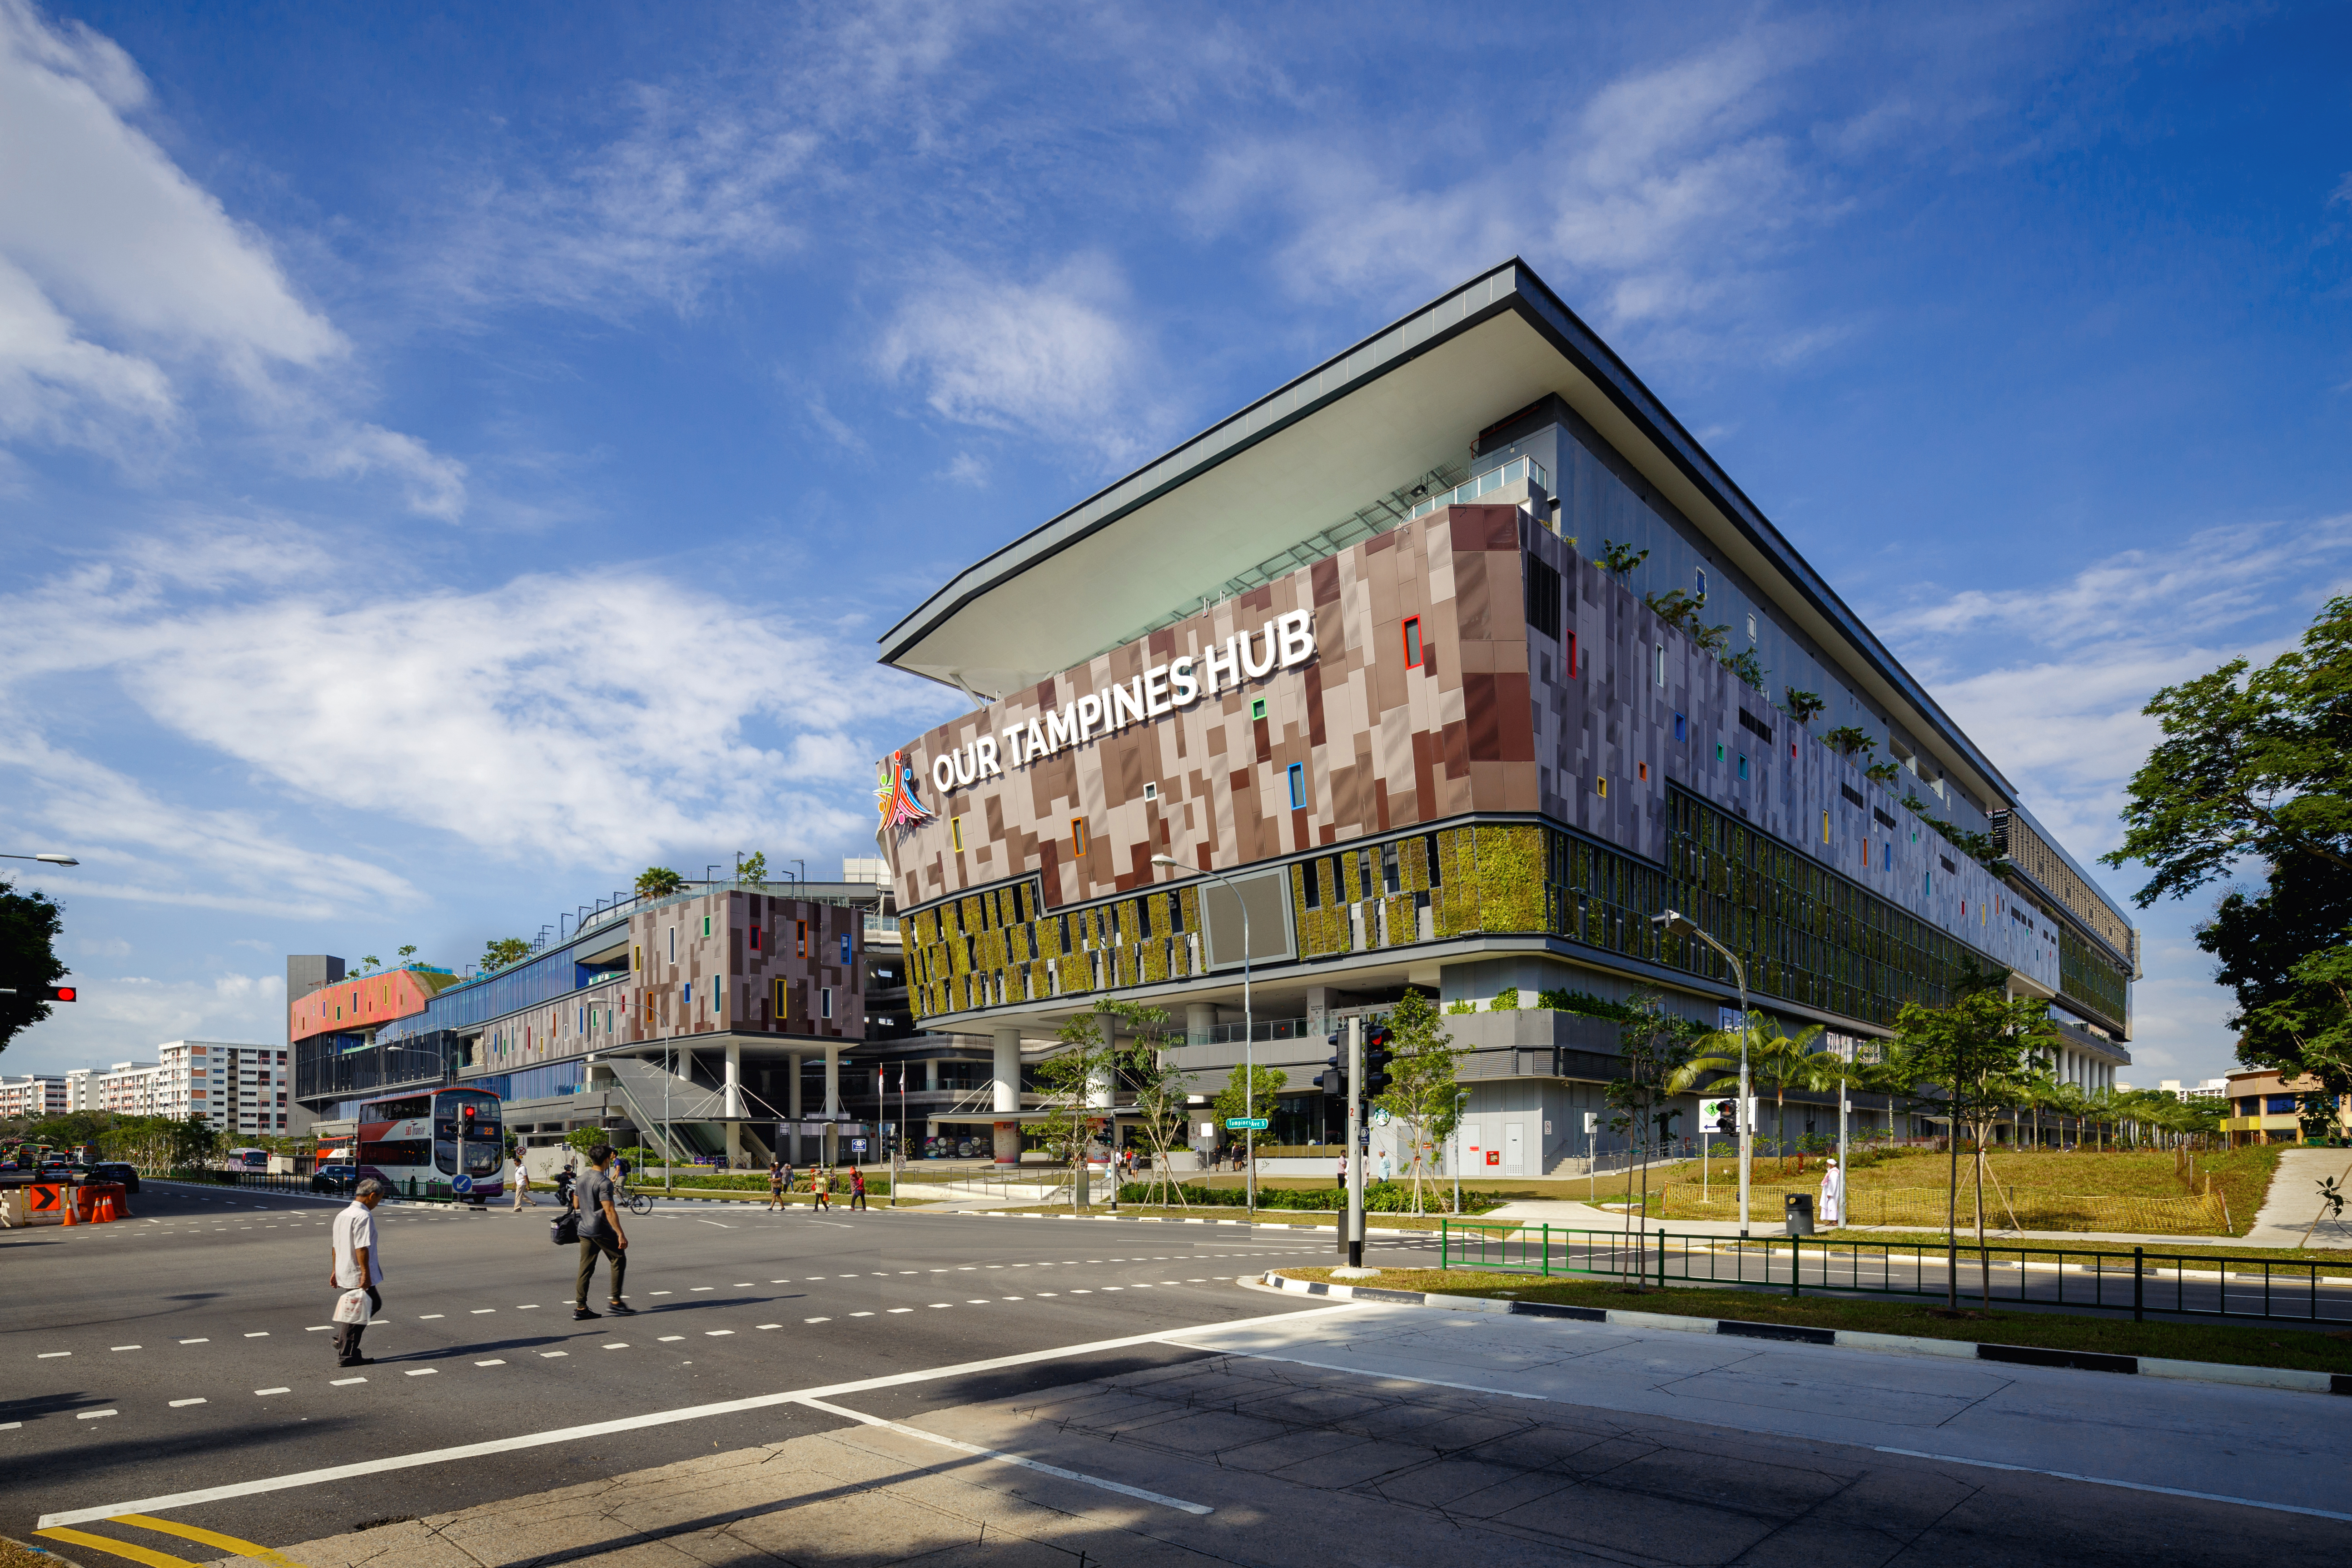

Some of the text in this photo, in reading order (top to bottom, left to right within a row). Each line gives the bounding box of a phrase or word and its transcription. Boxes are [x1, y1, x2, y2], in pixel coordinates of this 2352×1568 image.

[933, 608, 1315, 793] OUR TAMPINES HUB
[1350, 1108, 1354, 1116] 2
[412, 1123, 426, 1137] Transit
[484, 1127, 493, 1135] 22
